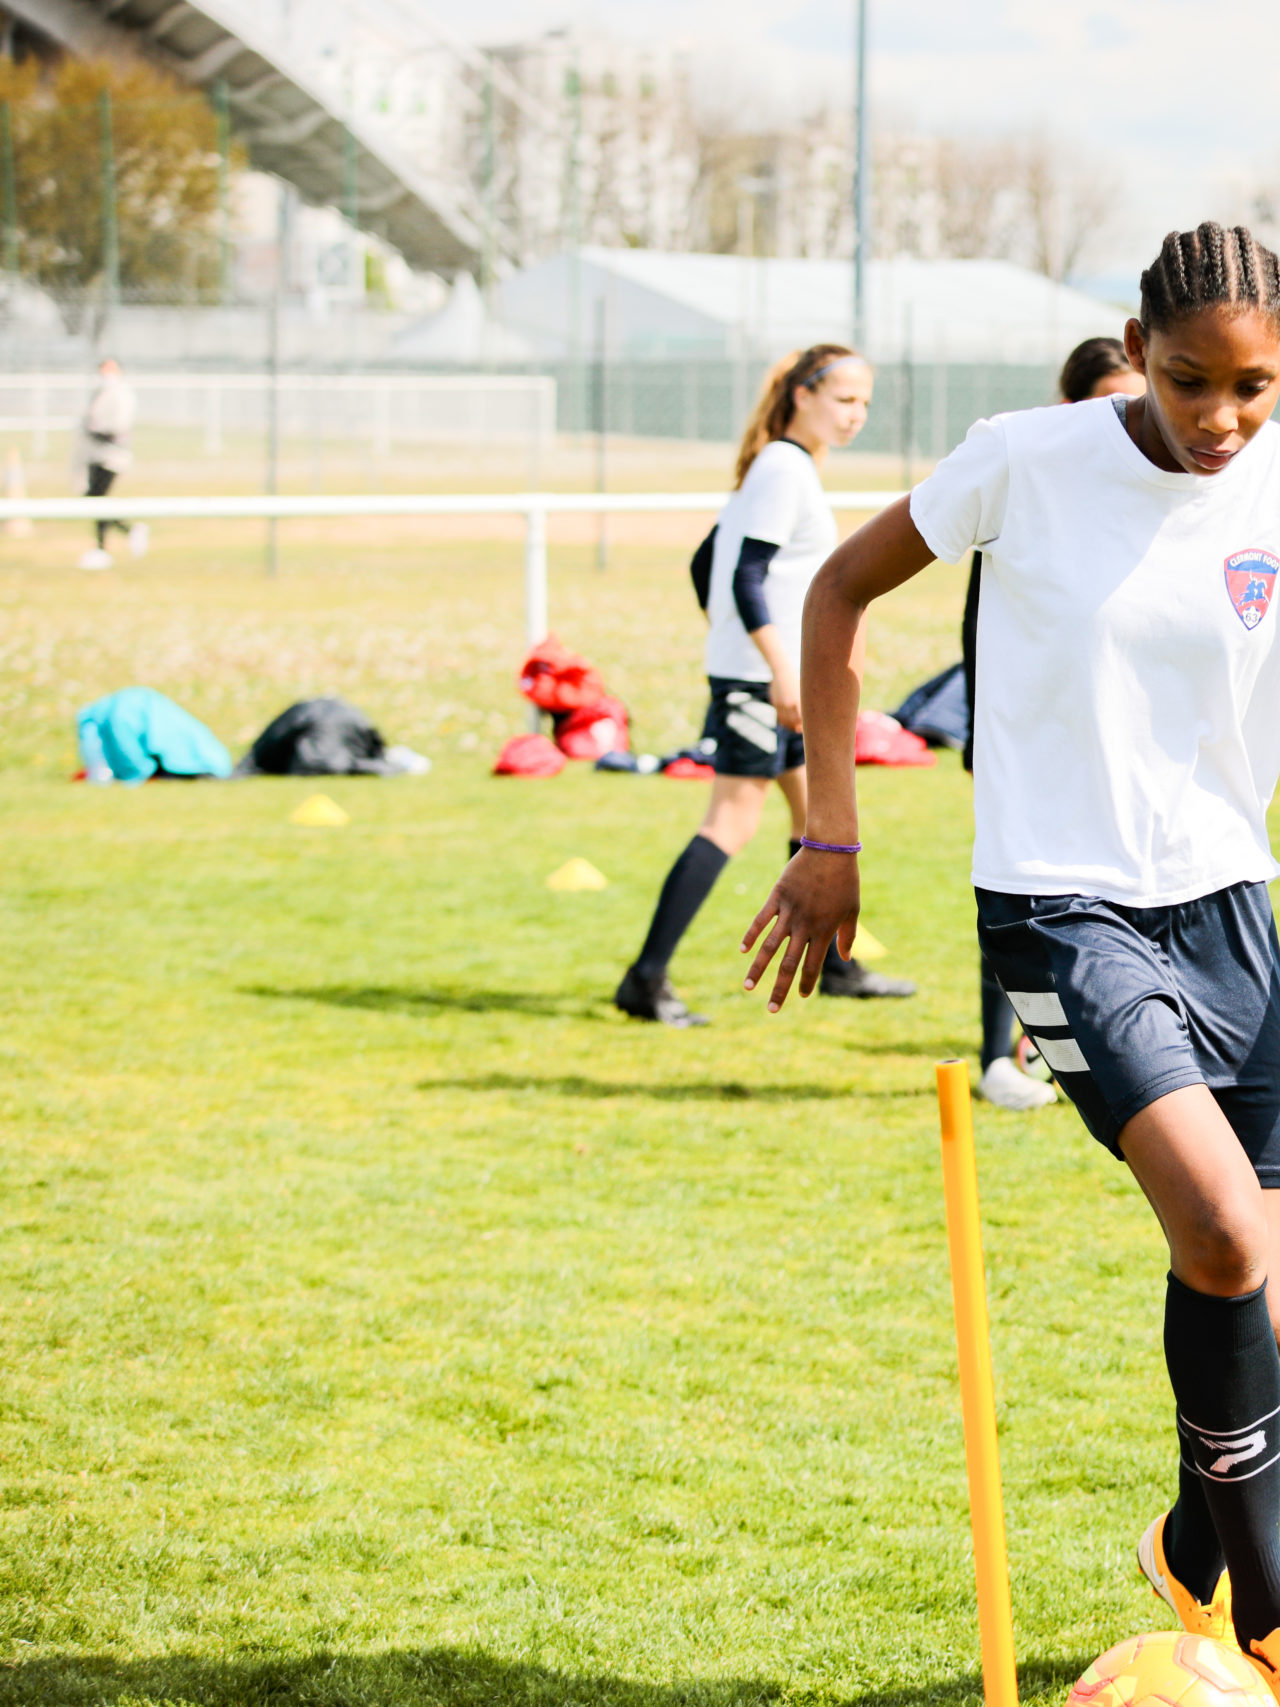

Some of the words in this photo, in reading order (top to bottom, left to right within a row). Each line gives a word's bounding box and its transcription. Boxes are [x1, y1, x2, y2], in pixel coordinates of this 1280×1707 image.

[1230, 552, 1262, 567] CLERMONT
[1263, 555, 1279, 570] FOOT
[1245, 612, 1258, 623] 63
